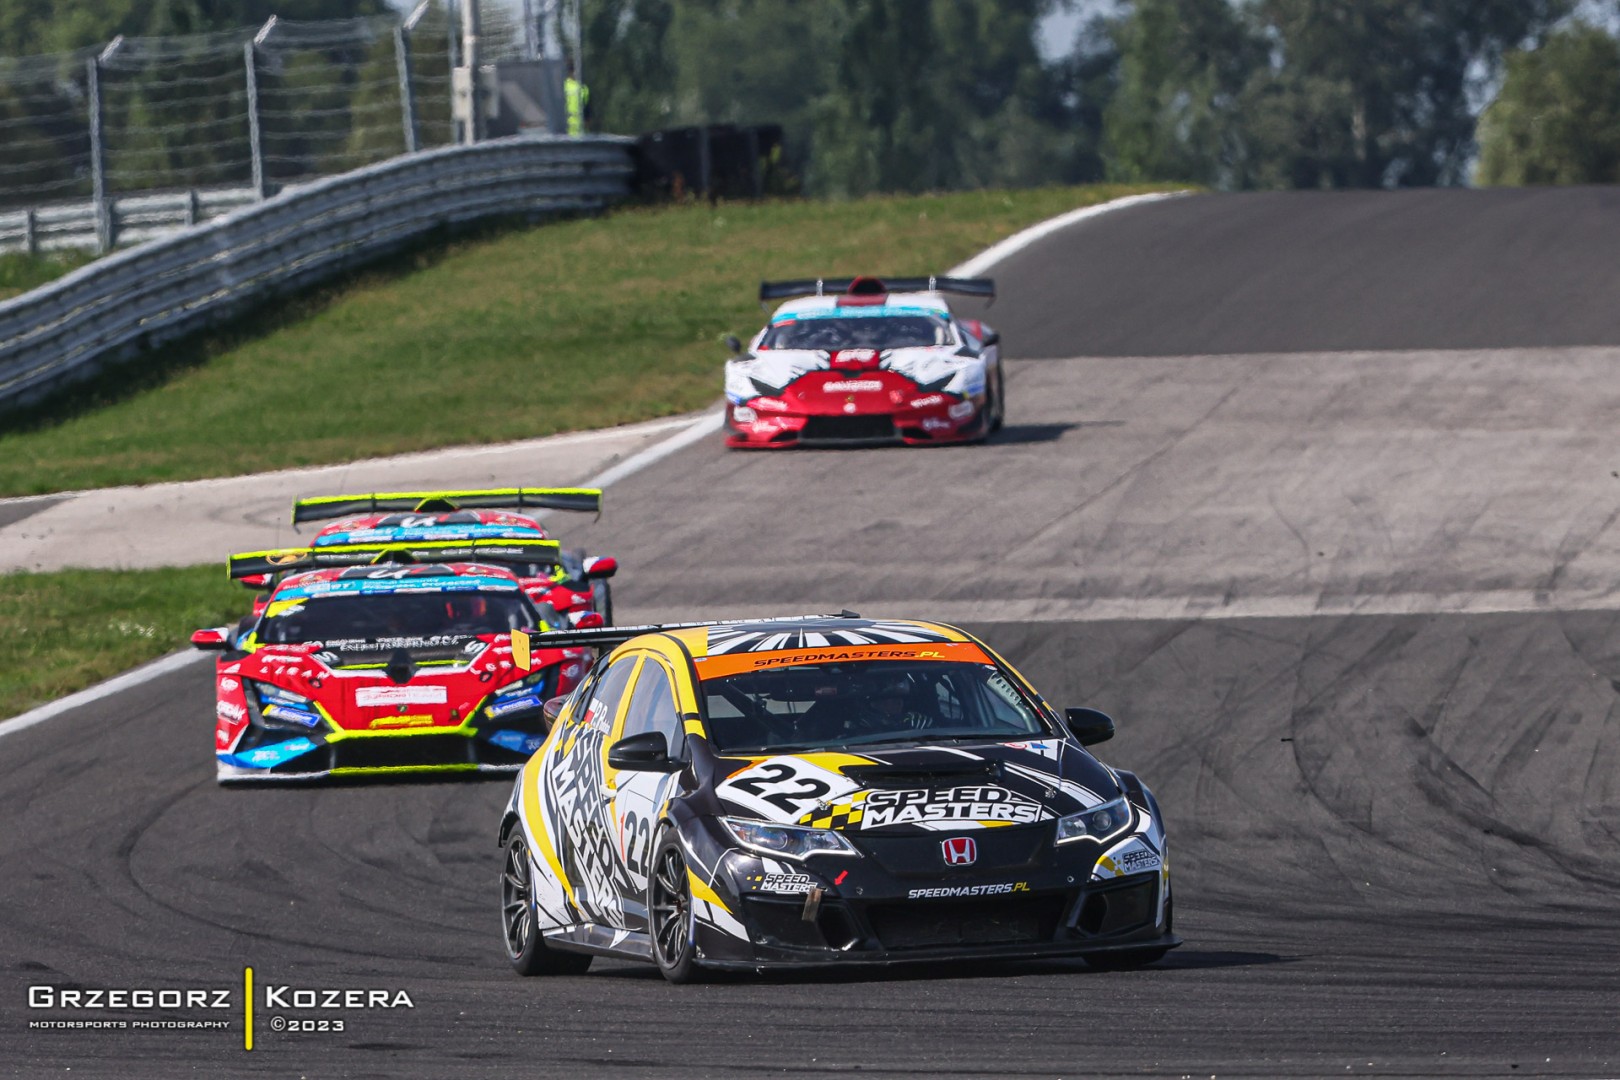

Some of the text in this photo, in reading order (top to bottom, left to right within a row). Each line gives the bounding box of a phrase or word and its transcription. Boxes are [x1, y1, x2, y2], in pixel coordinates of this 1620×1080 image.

[753, 650, 946, 668] SPEEDMASTERS.PL
[728, 763, 831, 814] 22
[866, 786, 1013, 806] SPEED
[861, 801, 1042, 831] MASTERS
[624, 810, 651, 874] 22
[1123, 850, 1149, 863] SPEED
[1124, 856, 1159, 873] MASTERS
[766, 873, 810, 884] SPEED
[908, 881, 1031, 899] SPEEDMASTERS.PL
